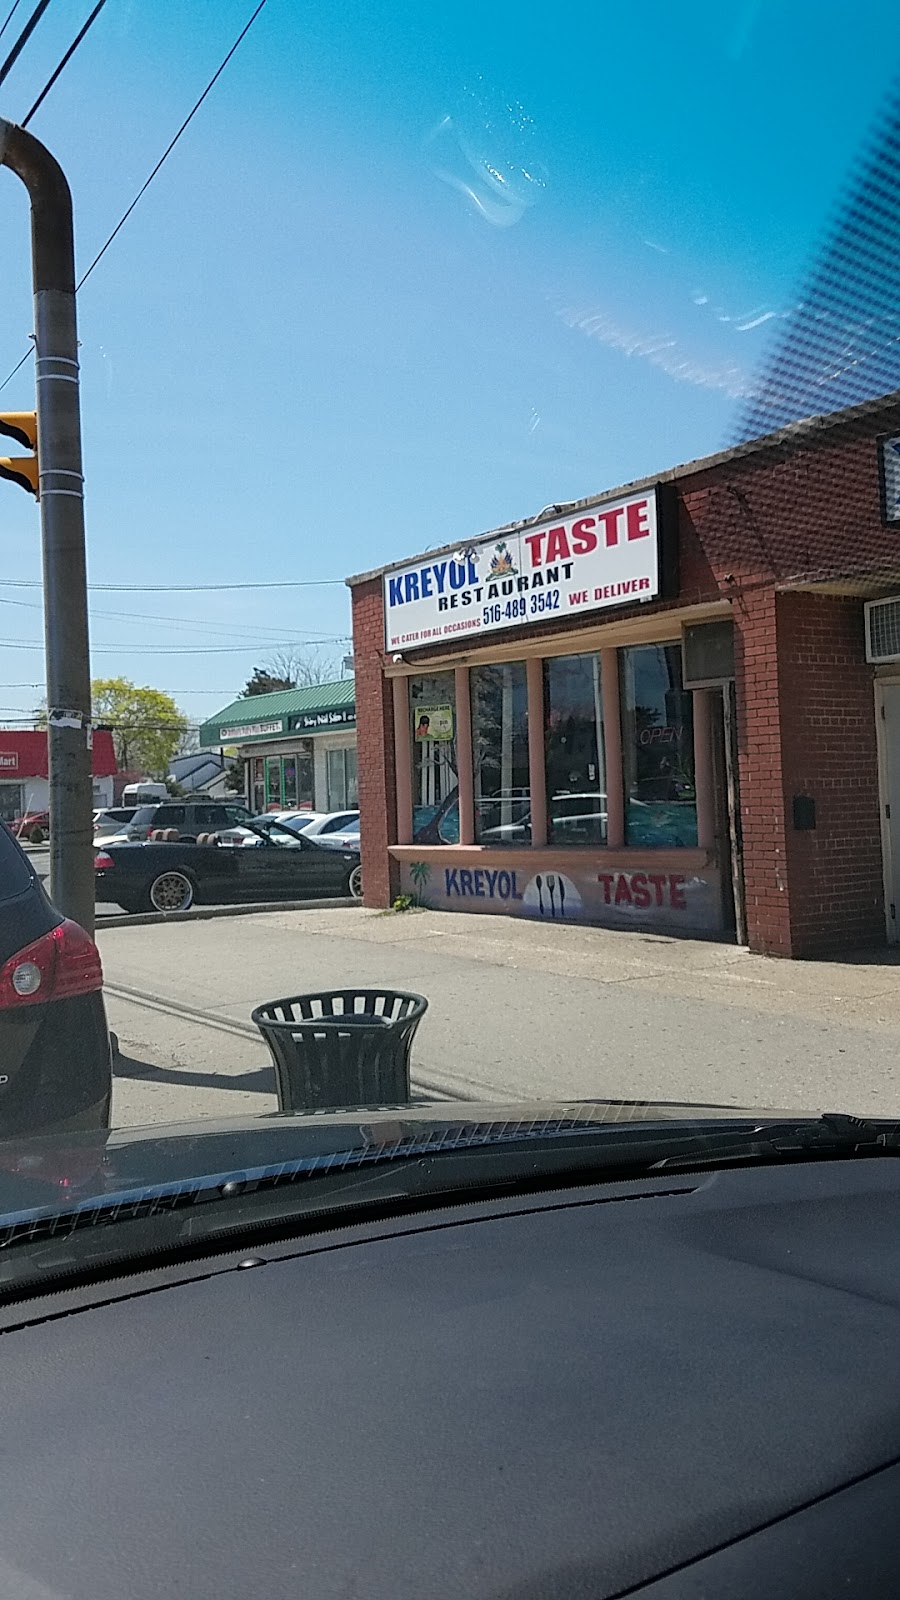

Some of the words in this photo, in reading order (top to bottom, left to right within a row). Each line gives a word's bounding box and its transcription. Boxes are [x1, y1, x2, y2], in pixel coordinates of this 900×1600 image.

[388, 555, 479, 608] KREYOL
[525, 500, 650, 568] TASTE
[439, 562, 574, 611] RESTAURANT
[569, 590, 589, 606] WE
[594, 577, 650, 601] DELIVER
[483, 597, 526, 625] 516-489
[530, 589, 560, 614] 3542
[391, 636, 400, 645] WE
[401, 632, 419, 643] CATER
[420, 629, 432, 639] FOR
[432, 627, 442, 636] ALL
[443, 618, 481, 633] OCCASIONS
[640, 726, 683, 744] OPEN
[444, 868, 523, 900] KREYOL
[598, 873, 687, 910] TASTE
